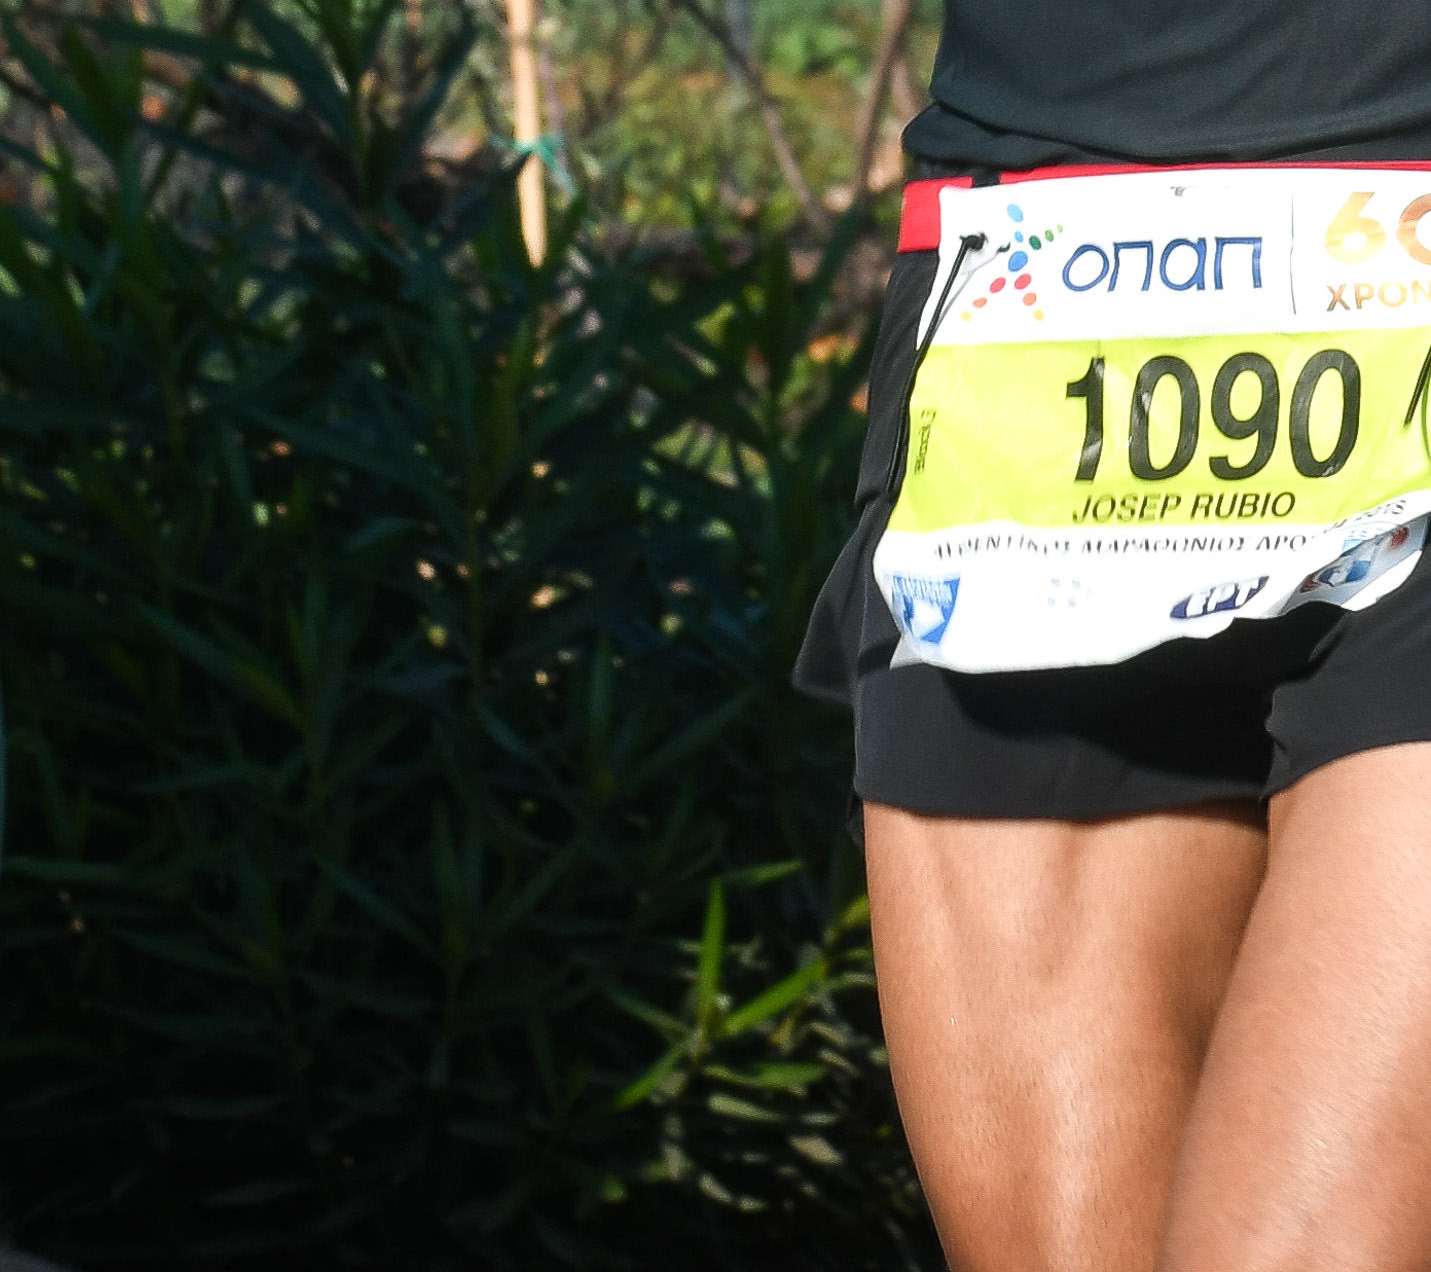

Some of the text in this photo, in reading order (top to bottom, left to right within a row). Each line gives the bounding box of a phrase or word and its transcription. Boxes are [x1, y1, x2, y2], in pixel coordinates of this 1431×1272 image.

[1065, 348, 1361, 485] 1090
[1072, 491, 1296, 524] JOSEP RUBIO
